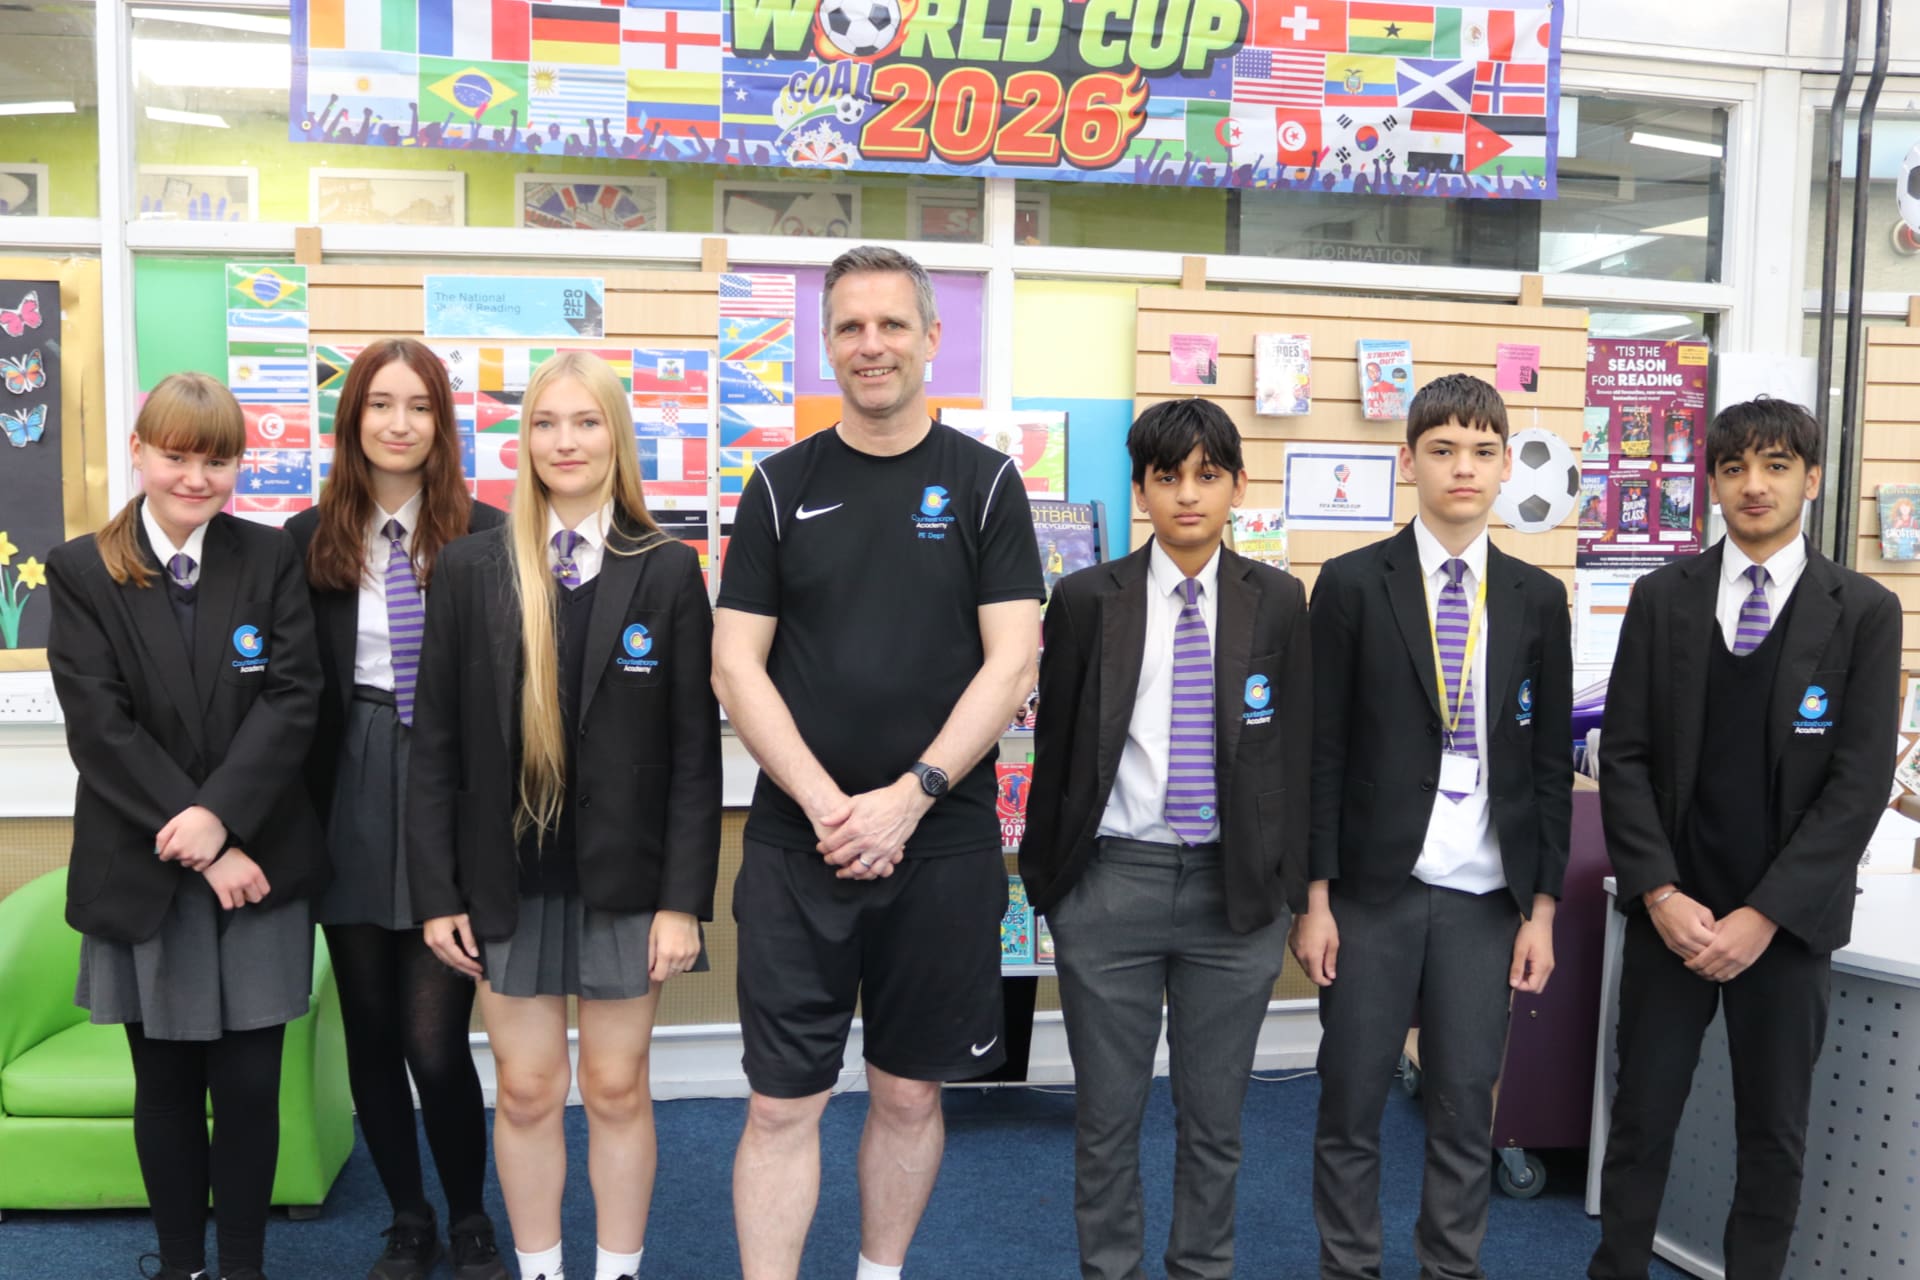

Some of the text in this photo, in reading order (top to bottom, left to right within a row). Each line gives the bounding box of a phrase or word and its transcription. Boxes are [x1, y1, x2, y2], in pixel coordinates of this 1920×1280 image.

[1080, 0, 1245, 71] CUP
[787, 59, 873, 103] GOAL
[861, 63, 1130, 168] 2026
[435, 291, 506, 302] The National
[563, 289, 584, 298] GO
[476, 303, 521, 315] Reading
[563, 299, 584, 308] ALL
[563, 308, 584, 317] IN.
[1366, 350, 1406, 360] STRIKING
[1638, 345, 1661, 357] THE
[1379, 358, 1396, 366] OUT
[1607, 358, 1666, 372] SEASON
[1591, 373, 1683, 387] FOR READING
[1621, 509, 1646, 523] CLASS
[916, 522, 948, 530] Academy
[1794, 726, 1826, 736] Academy
